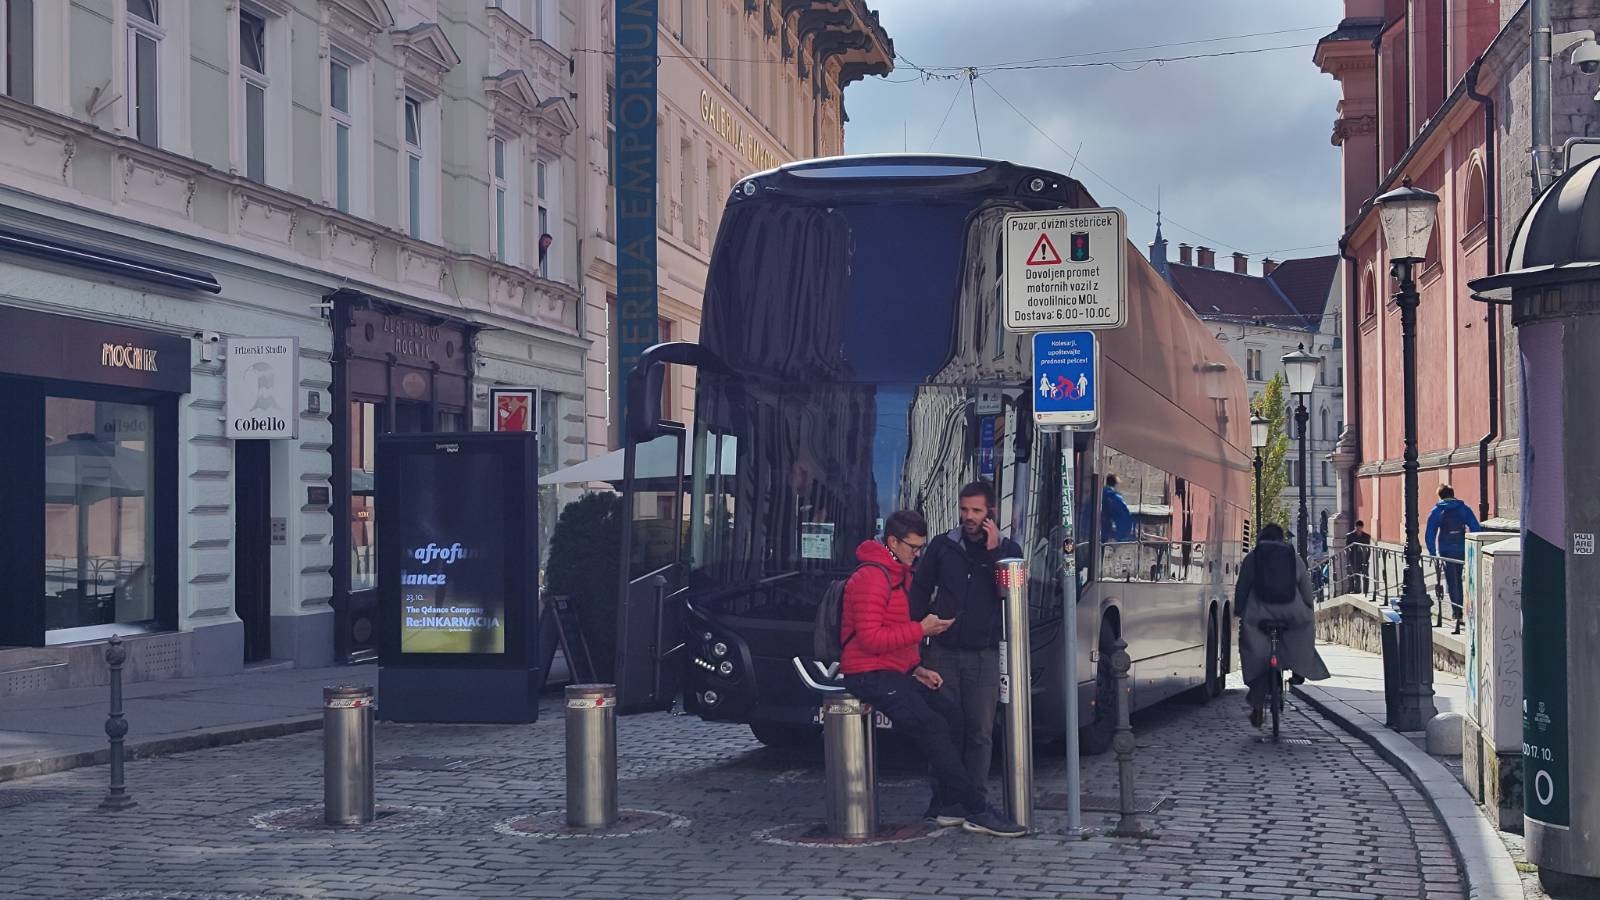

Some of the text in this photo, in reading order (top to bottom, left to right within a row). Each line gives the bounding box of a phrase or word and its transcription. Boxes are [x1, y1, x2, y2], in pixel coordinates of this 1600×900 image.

[701, 89, 745, 156] GALERIJA
[1012, 216, 1112, 231] Pozor, dvižni stebriček
[1025, 266, 1100, 280] Dovoljen promet
[1027, 280, 1098, 293] motornih vozil z
[622, 233, 652, 366] ERIJA
[1027, 294, 1098, 307] dovolilnico MOL
[1015, 310, 1055, 321] Dostava:
[265, 344, 287, 354] Studio
[234, 416, 286, 432] Cobello
[421, 606, 449, 614] Qdance
[1541, 748, 1554, 762] 10.
